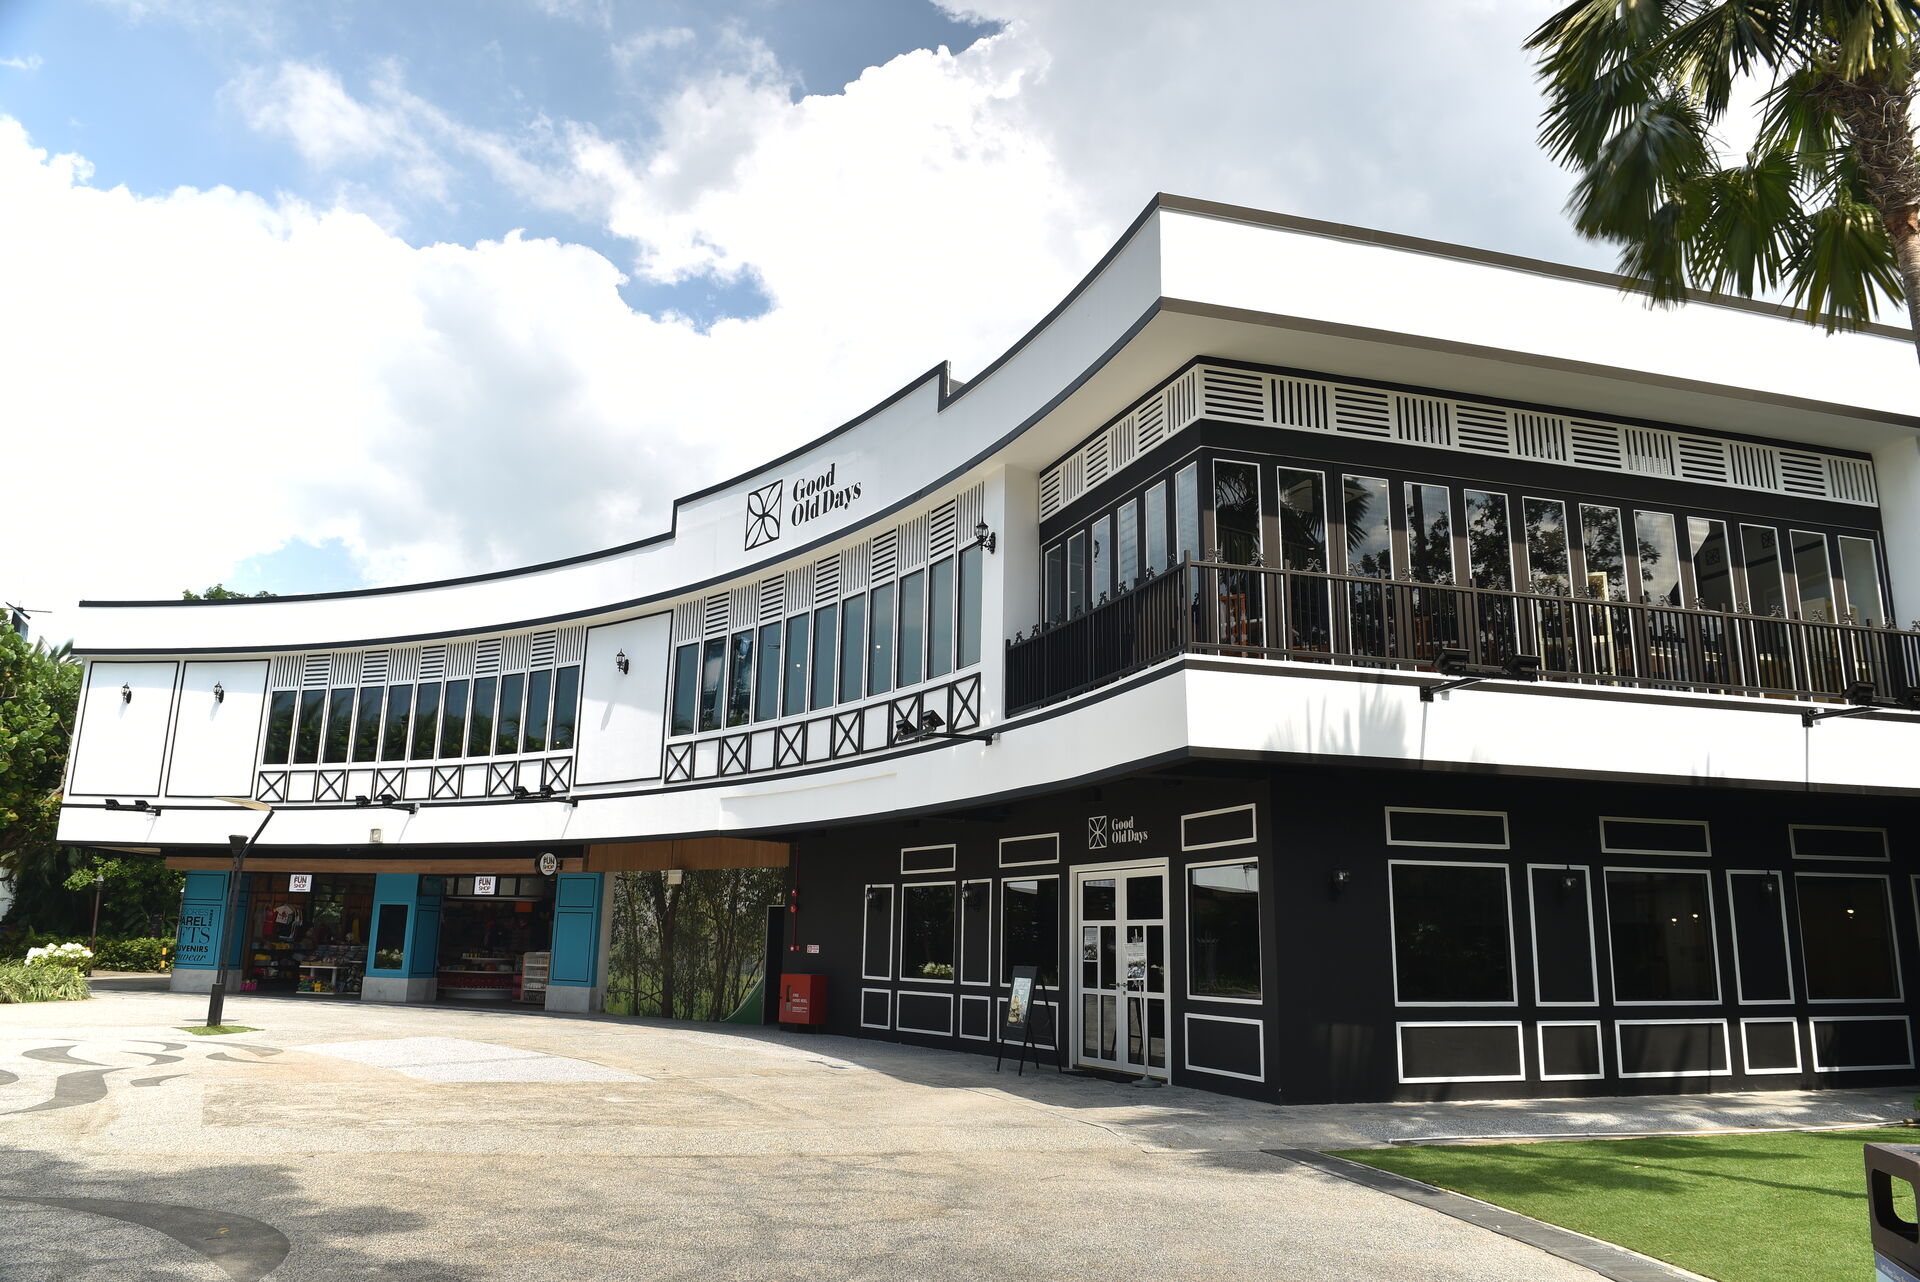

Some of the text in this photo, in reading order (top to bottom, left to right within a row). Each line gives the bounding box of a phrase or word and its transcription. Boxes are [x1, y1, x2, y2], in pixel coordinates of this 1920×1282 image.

[793, 463, 835, 502] Good
[791, 482, 861, 526] Old Days
[1112, 816, 1133, 830] Good
[1112, 830, 1148, 844] Old Days
[543, 856, 555, 865] FUN
[294, 876, 307, 884] FUN
